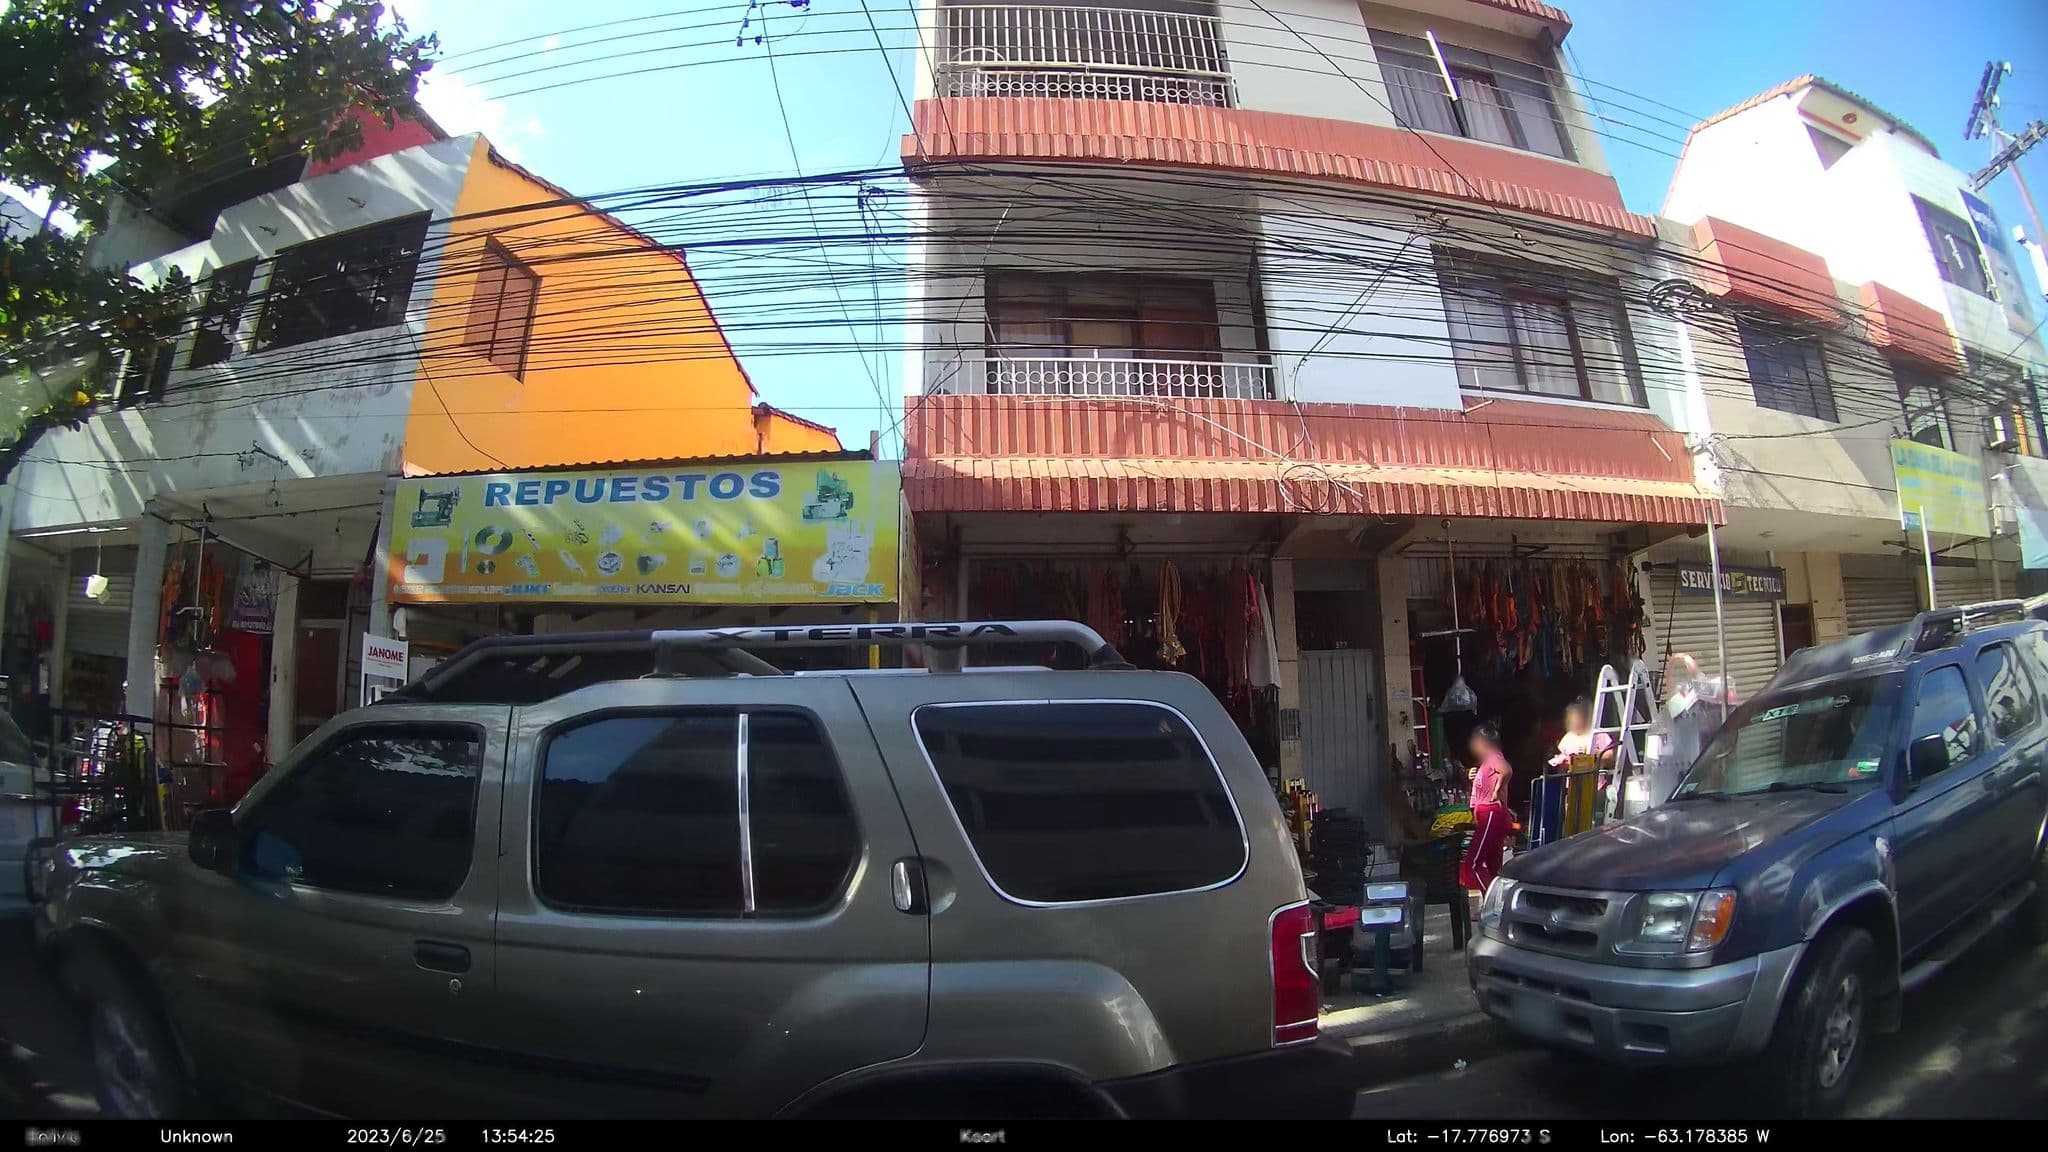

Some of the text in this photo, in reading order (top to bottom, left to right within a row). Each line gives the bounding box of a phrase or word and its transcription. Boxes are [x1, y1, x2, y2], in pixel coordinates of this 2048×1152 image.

[485, 471, 781, 507] REPUESTOS
[636, 584, 690, 594] KANSAI
[706, 624, 1018, 641] XTERRA
[368, 646, 404, 662] JANOME
